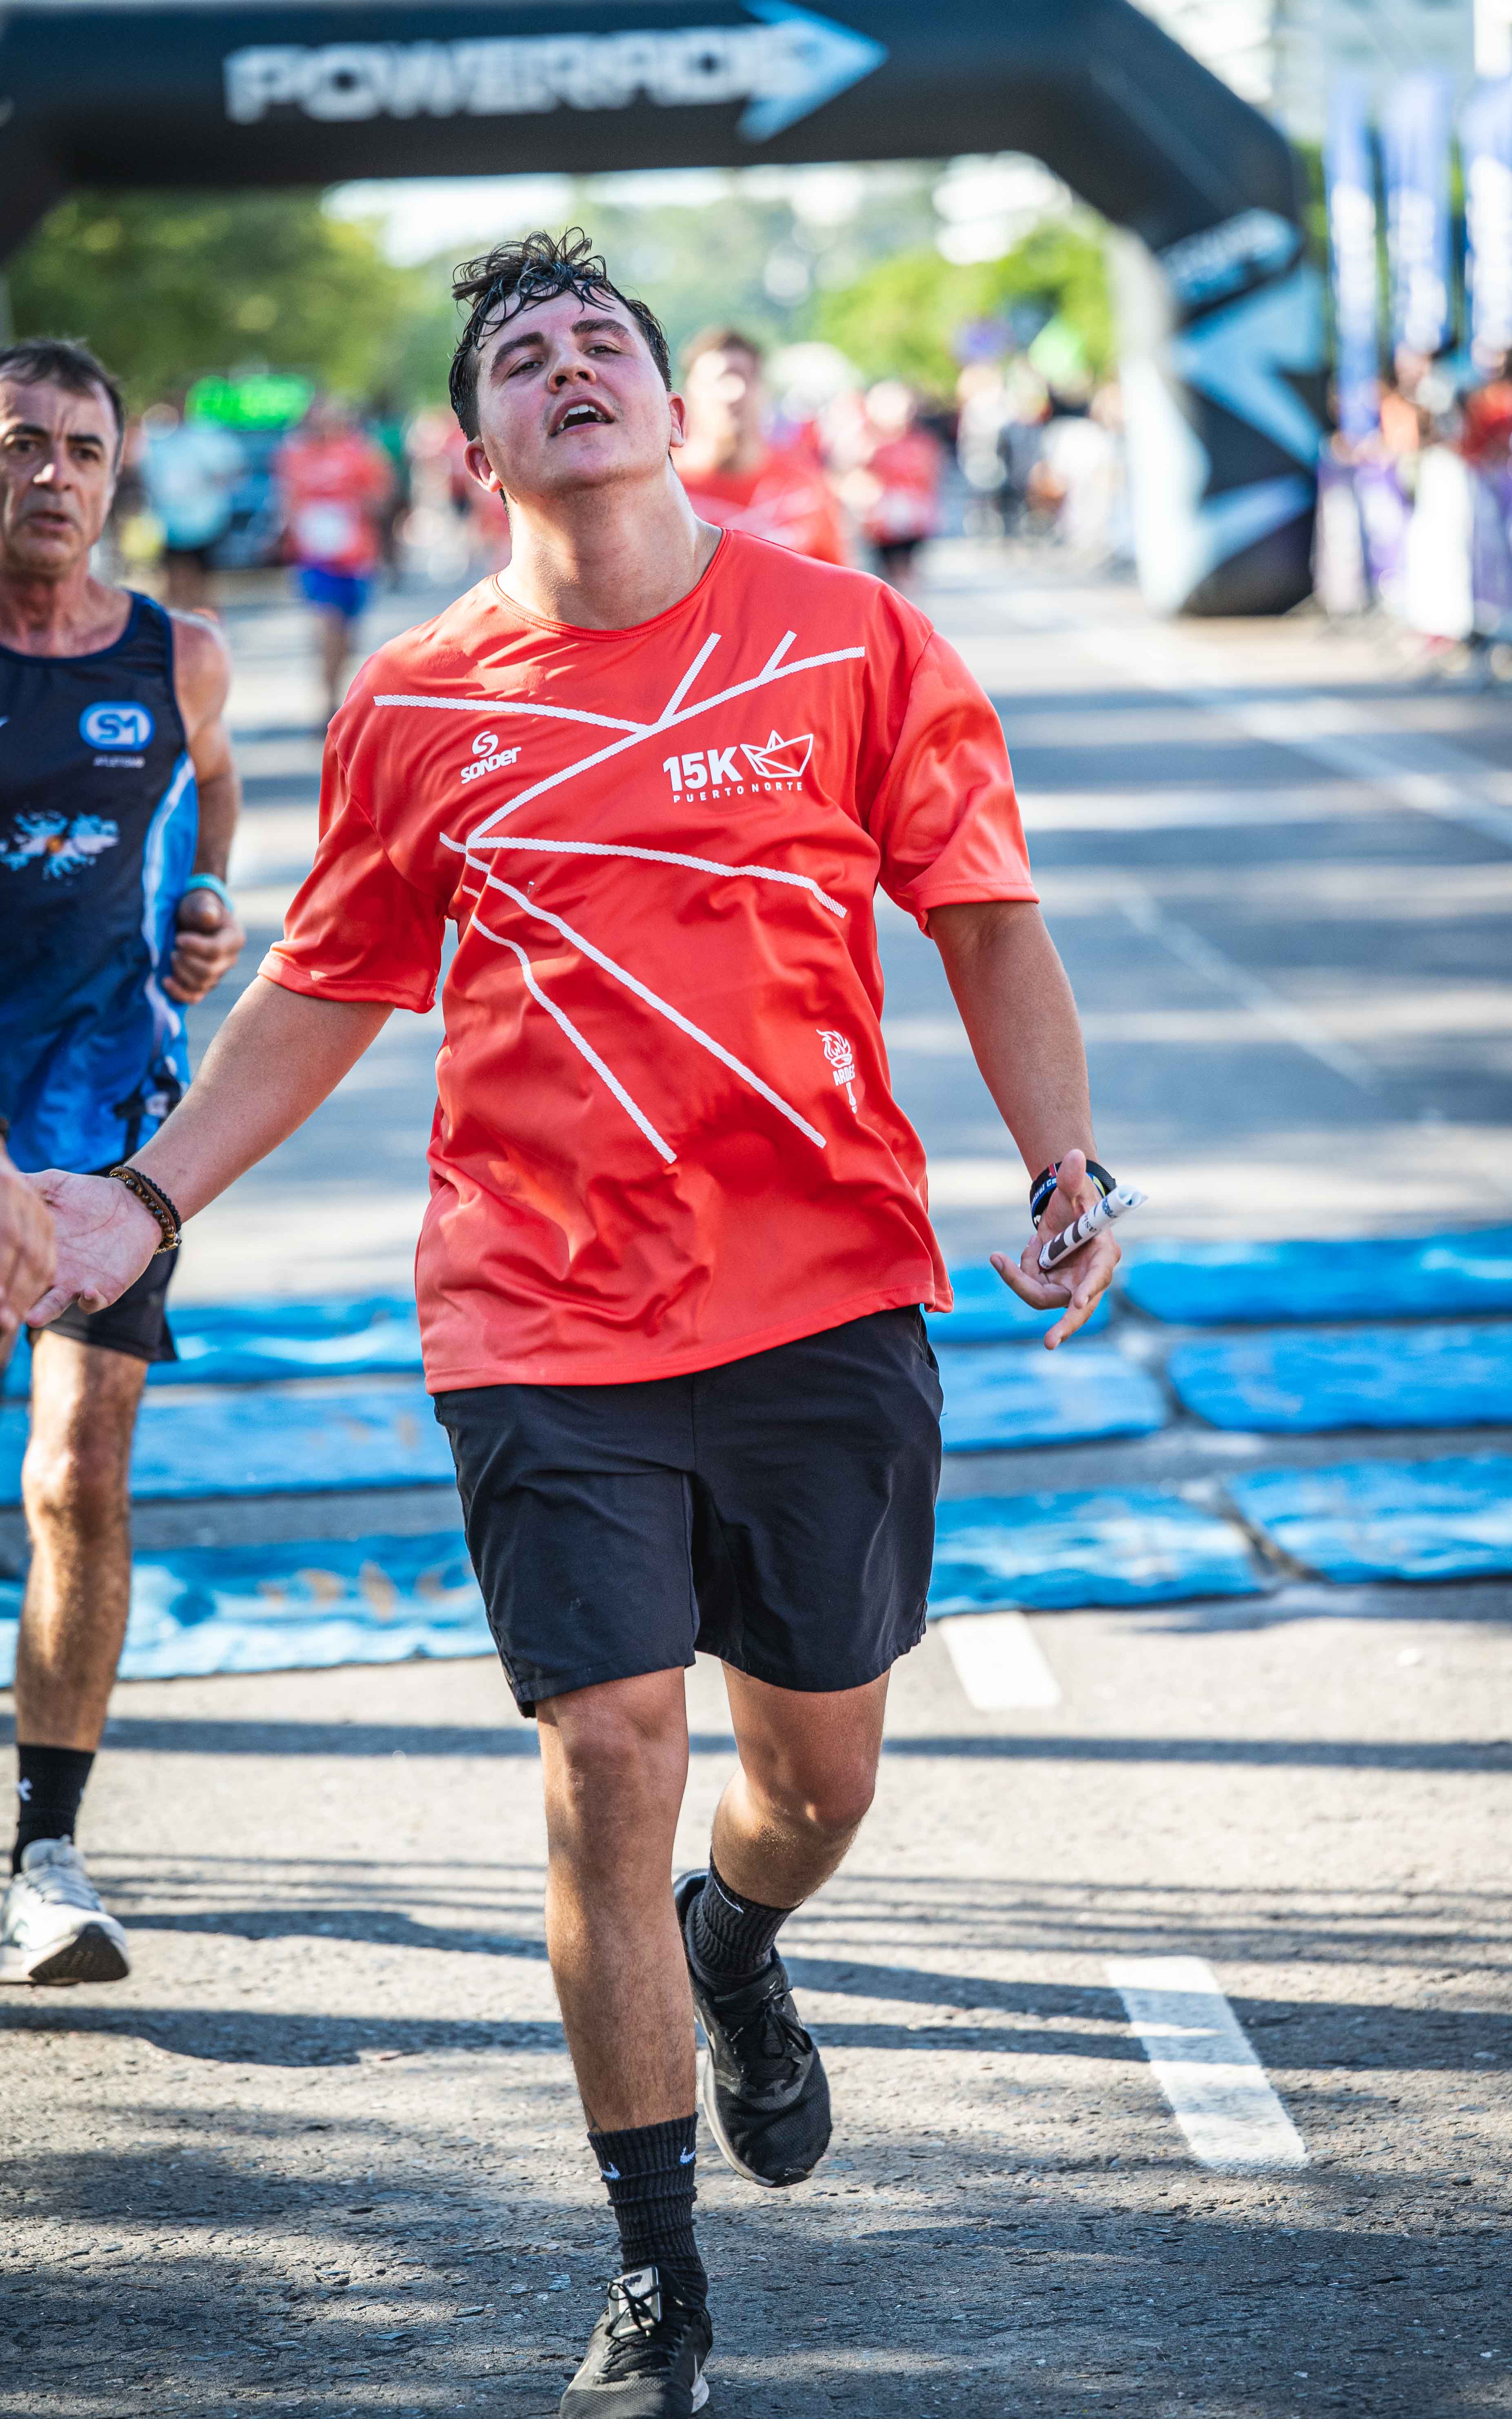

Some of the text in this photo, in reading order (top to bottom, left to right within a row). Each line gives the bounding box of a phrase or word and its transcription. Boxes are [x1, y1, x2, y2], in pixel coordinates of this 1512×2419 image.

[662, 746, 743, 792] 15K
[673, 781, 803, 803] PUERTO NORTE
